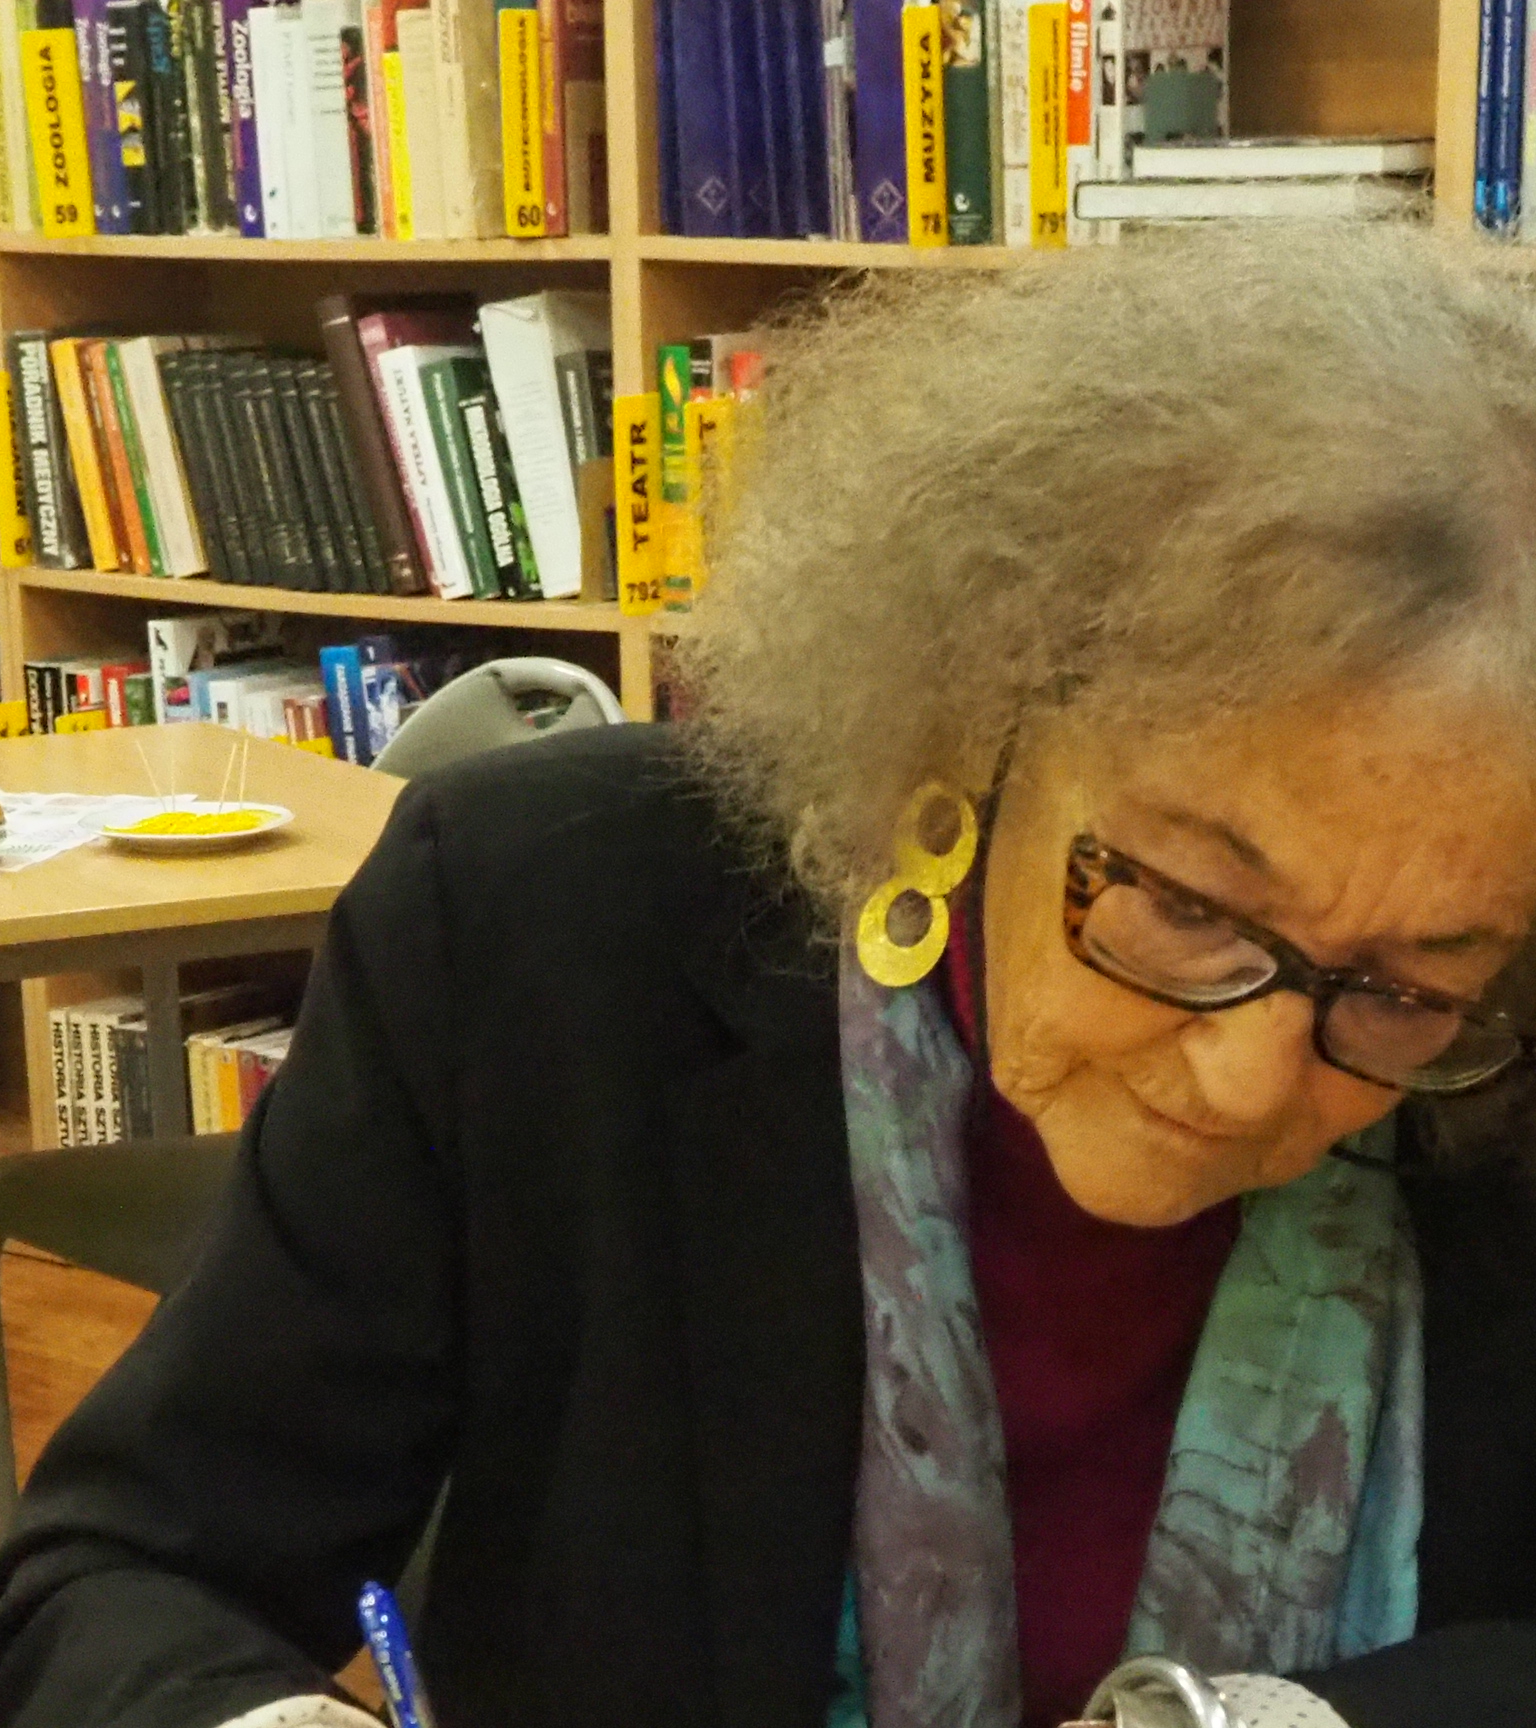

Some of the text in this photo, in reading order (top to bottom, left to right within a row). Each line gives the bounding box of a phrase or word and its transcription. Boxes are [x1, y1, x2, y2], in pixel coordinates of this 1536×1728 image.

[230, 20, 253, 119] Zoologia
[39, 45, 71, 189] ZOOLOGIA
[917, 33, 939, 184] MUZYKA
[54, 204, 78, 226] 59
[517, 205, 542, 229] 60
[19, 341, 59, 571] PORADNIK MEDYCZNY
[630, 420, 650, 553] TEATR
[627, 581, 660, 604] 792
[52, 1021, 67, 1089] HISTORIA
[71, 1022, 86, 1091] HISTORIA
[90, 1022, 105, 1093] HISTORIA
